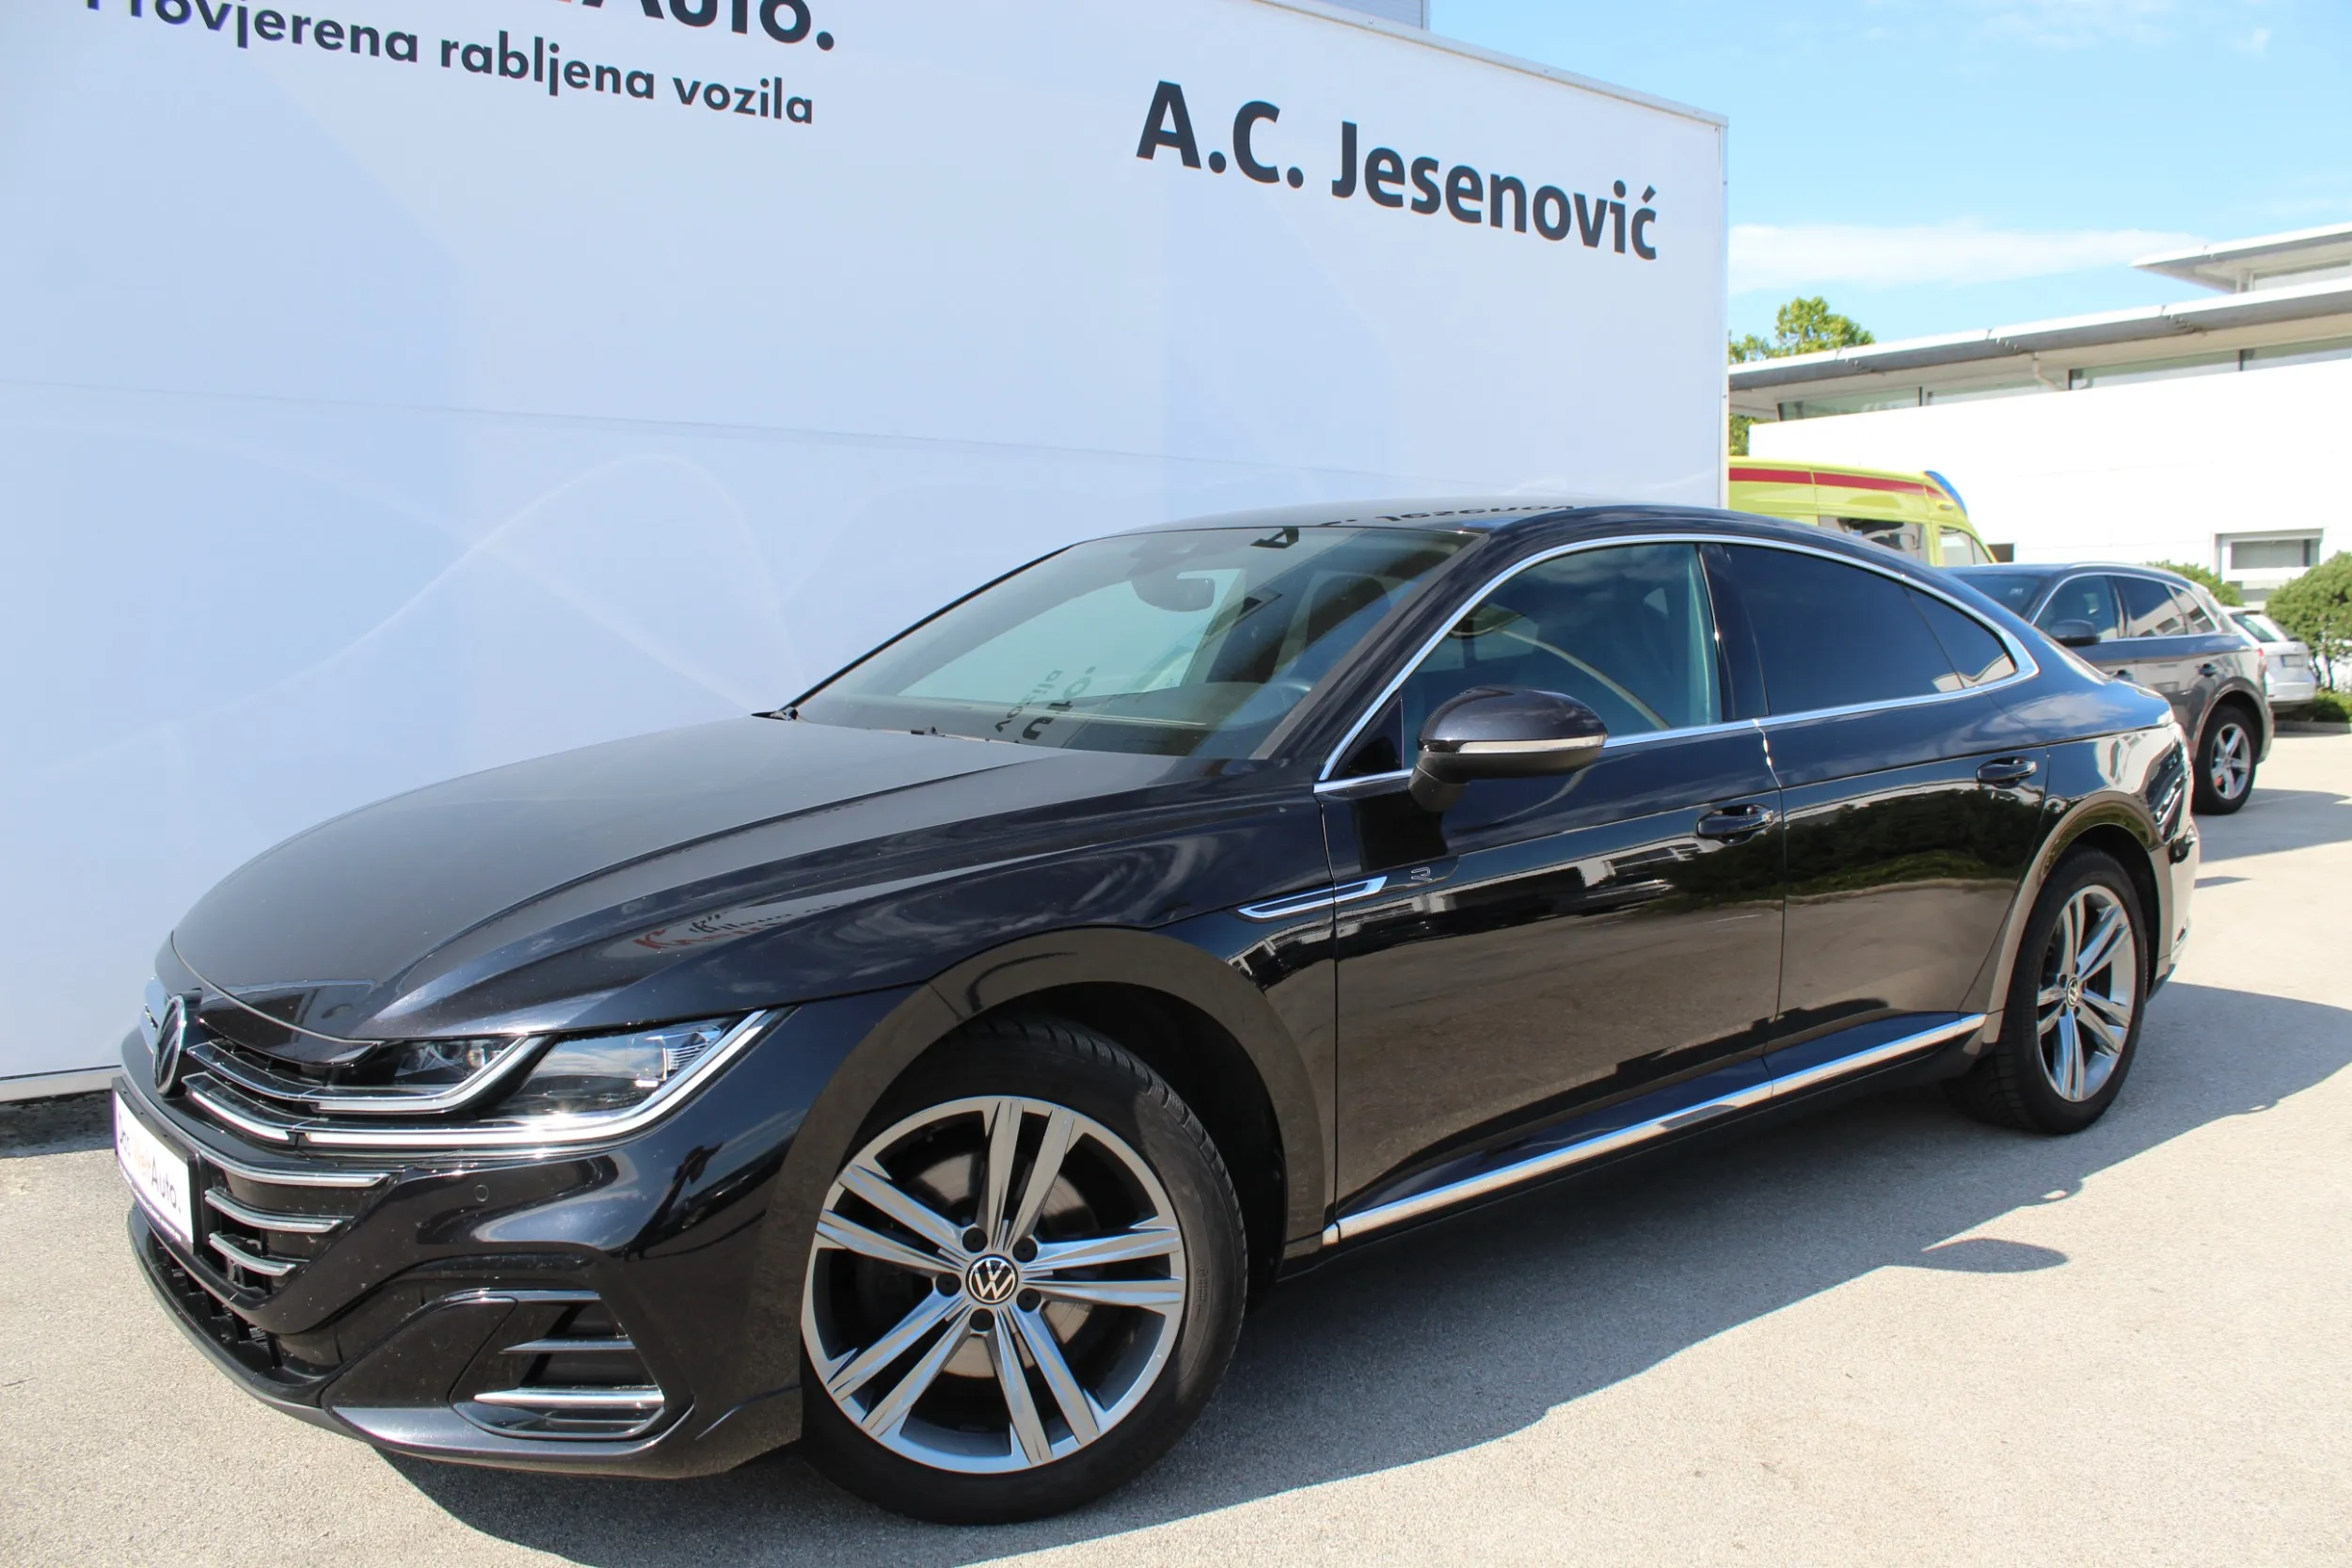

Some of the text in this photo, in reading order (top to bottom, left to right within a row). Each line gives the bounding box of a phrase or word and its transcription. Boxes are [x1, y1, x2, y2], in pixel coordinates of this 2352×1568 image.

[87, 0, 813, 125] ovjerena rabljena vozila
[1136, 80, 1657, 261] A.C. Jesenović
